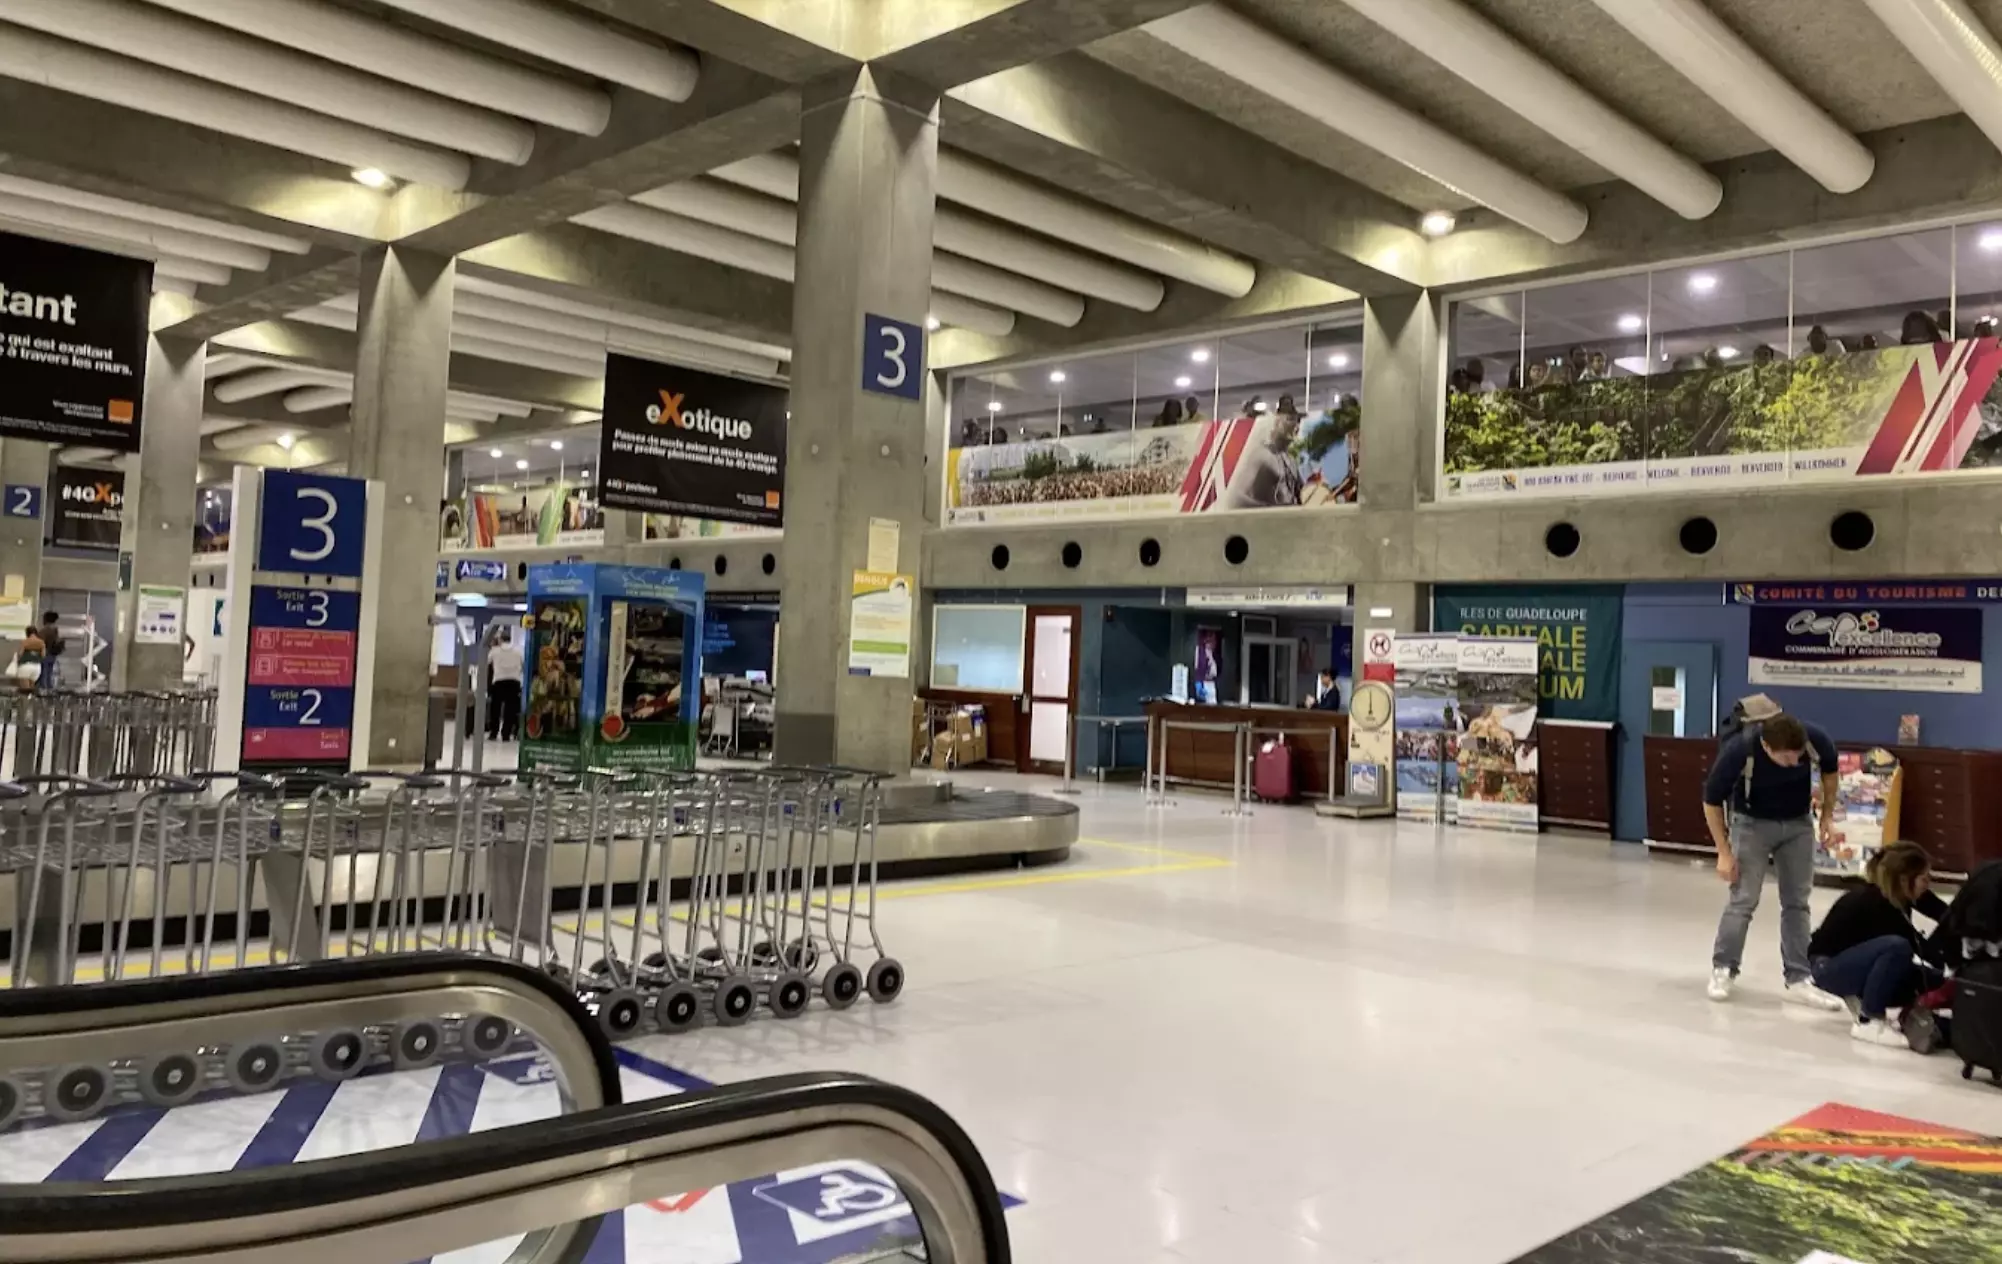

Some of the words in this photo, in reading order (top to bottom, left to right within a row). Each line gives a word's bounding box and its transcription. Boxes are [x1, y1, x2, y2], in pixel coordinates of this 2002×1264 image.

[877, 326, 906, 388] 3
[645, 388, 752, 440] eXotique
[12, 487, 32, 516] 2
[289, 487, 338, 561] 3
[1833, 587, 1858, 599] DU
[1867, 586, 1967, 599] TOURISME
[1976, 587, 2002, 599] DE
[305, 590, 329, 627] 3
[1506, 607, 1588, 621] GUADELOUPE
[1837, 629, 1942, 647] excellence
[1539, 650, 1587, 673] ALE
[1538, 675, 1585, 700] UM
[299, 688, 322, 725] 2
